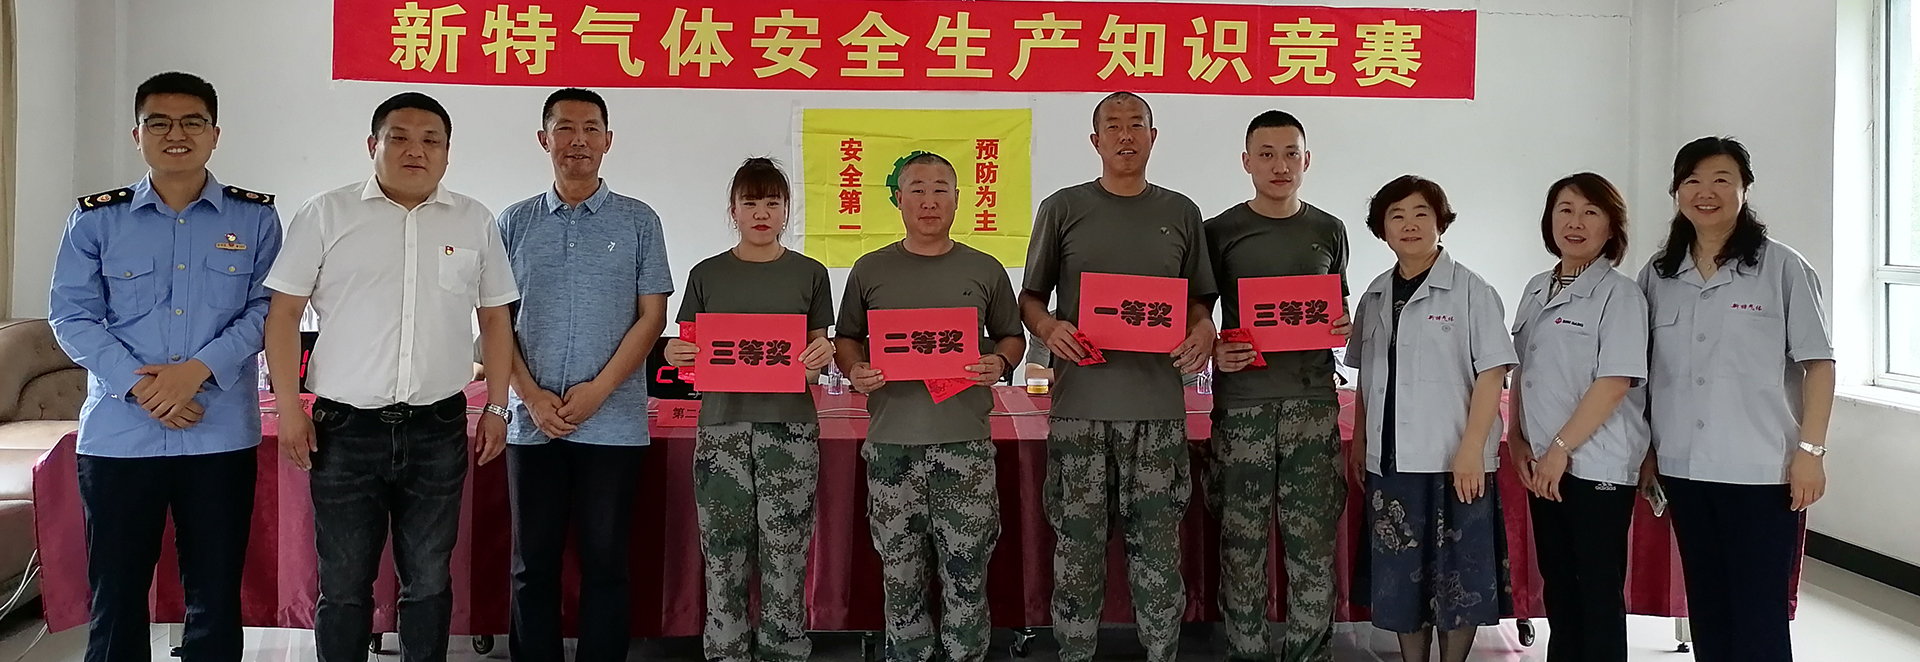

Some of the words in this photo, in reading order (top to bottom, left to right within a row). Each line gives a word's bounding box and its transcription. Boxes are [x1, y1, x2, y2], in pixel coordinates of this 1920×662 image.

[388, 1, 1423, 88] 新特气体安全生产知识竞赛
[838, 138, 864, 231] 安全第一
[973, 138, 1000, 232] 预防为主
[1093, 299, 1173, 328] 一等奖
[1253, 299, 1330, 327] 三等奖
[709, 339, 792, 366] 三等奖
[883, 329, 965, 354] 二等奖
[672, 407, 701, 419] 第二
